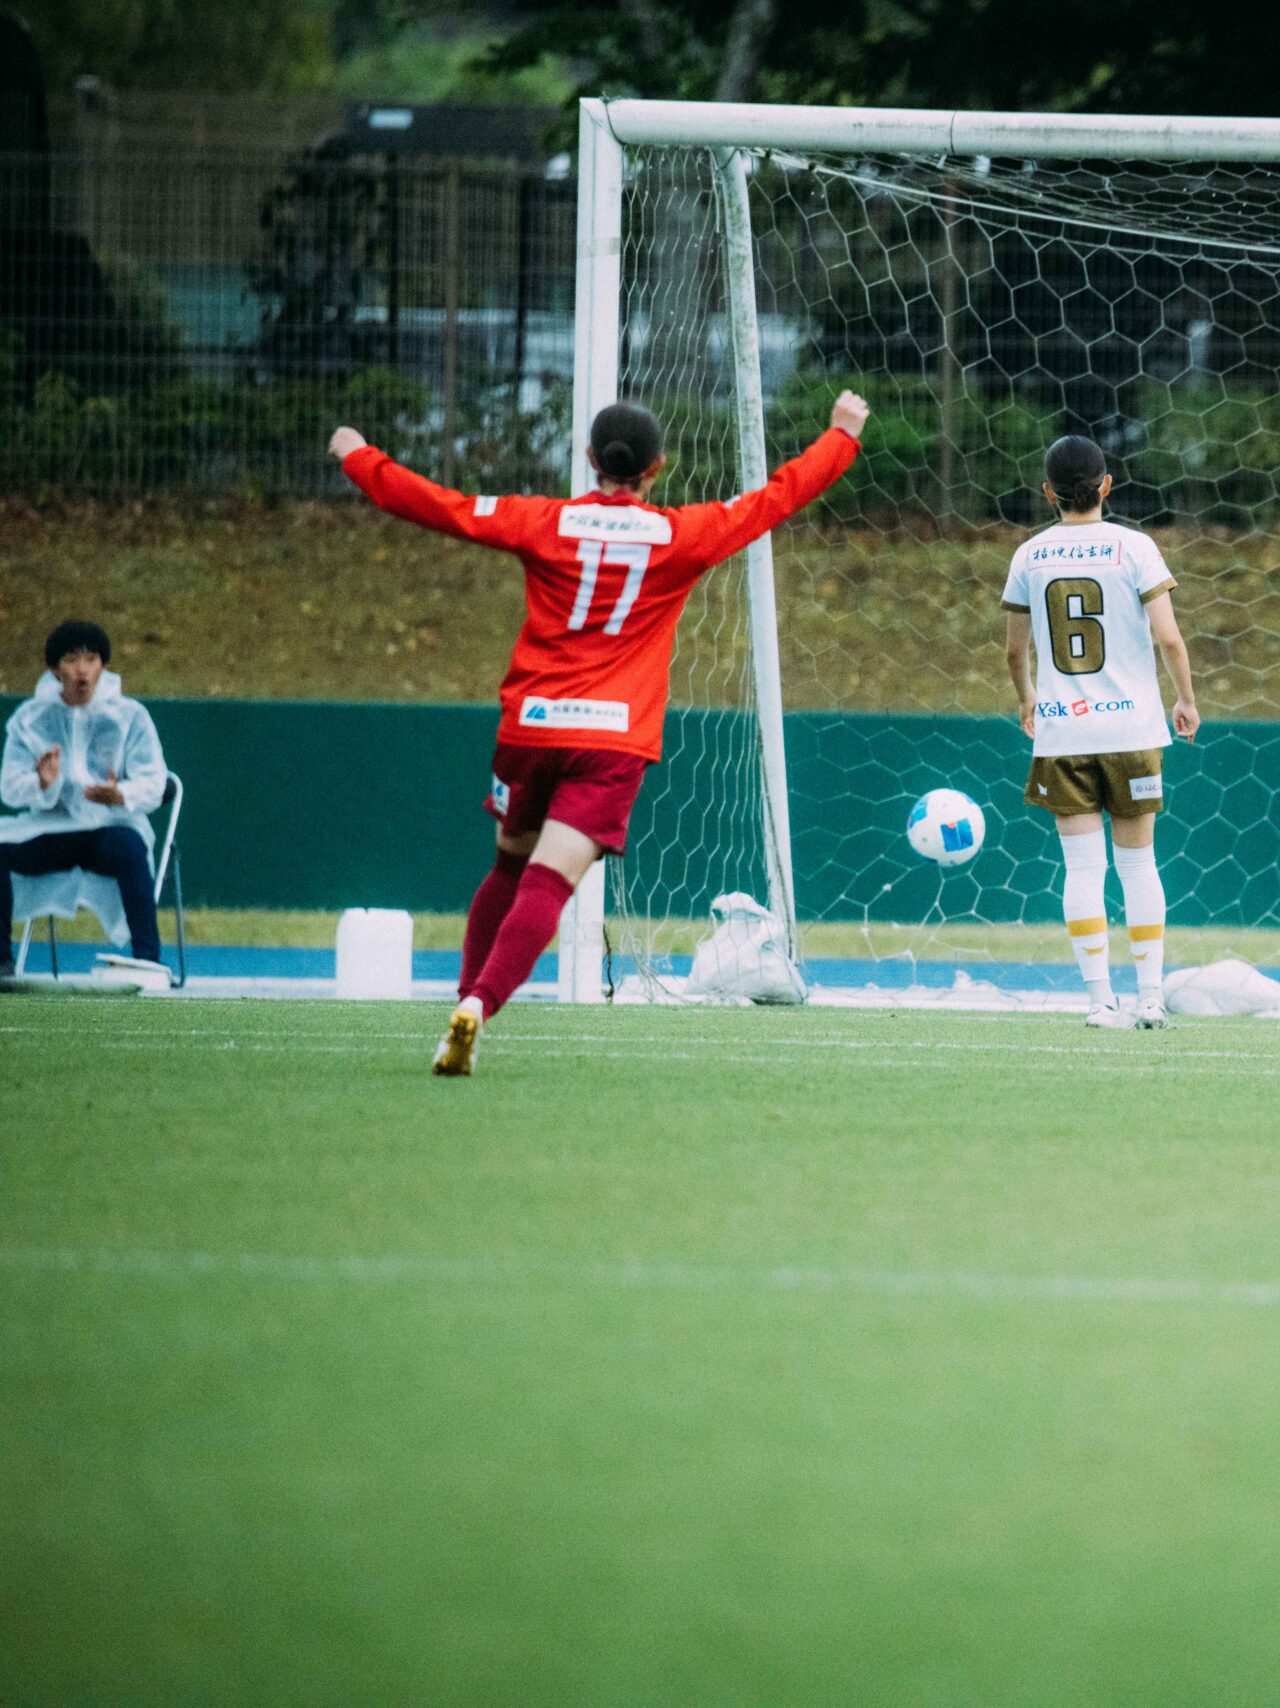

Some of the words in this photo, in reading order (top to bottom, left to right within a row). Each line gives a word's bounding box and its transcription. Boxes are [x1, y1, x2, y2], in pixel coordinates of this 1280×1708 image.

[567, 539, 652, 635] 17
[1045, 577, 1105, 676] 6
[1037, 701, 1069, 718] Ysk
